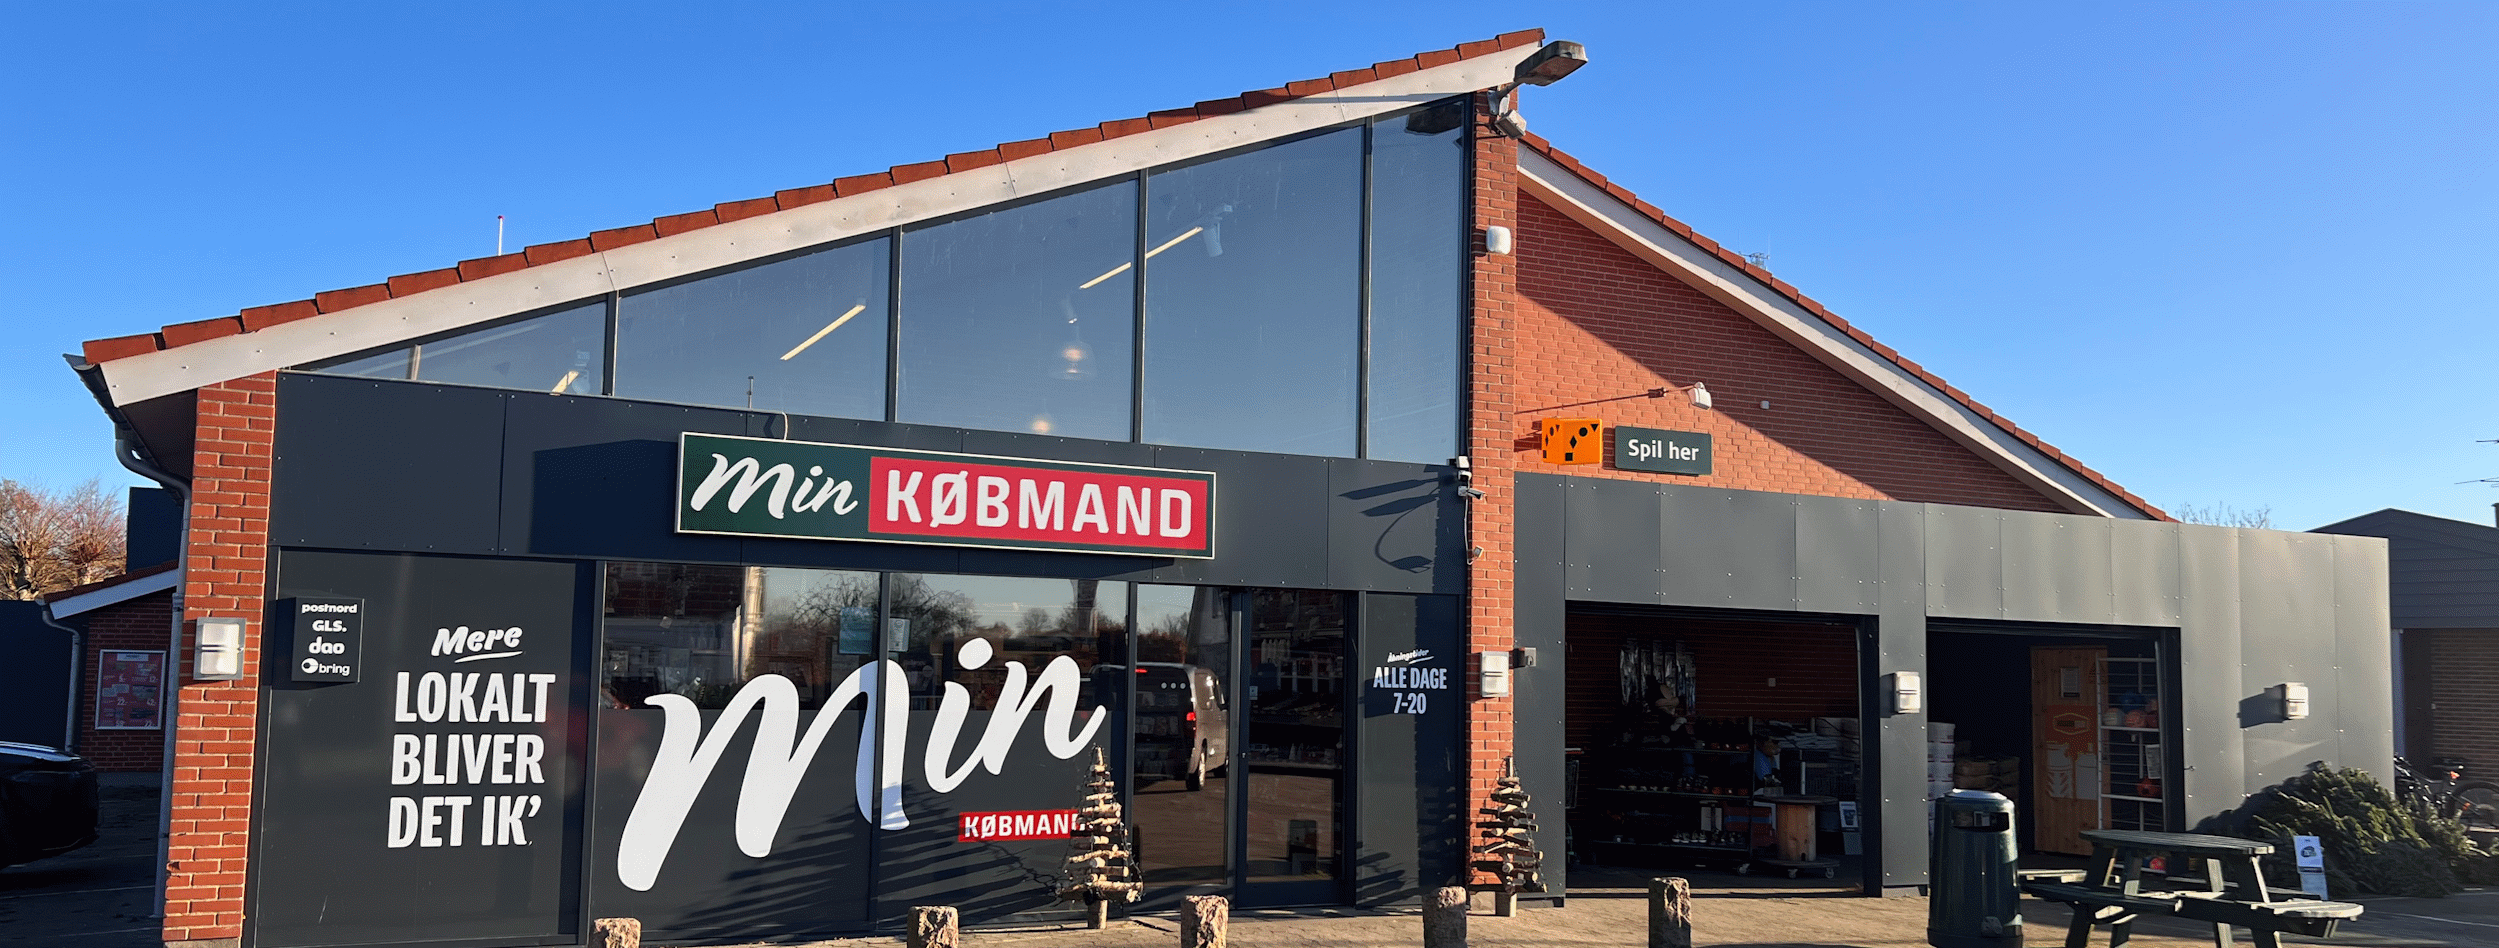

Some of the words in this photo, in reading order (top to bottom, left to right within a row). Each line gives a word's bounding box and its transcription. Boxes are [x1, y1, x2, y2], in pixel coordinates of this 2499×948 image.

[1627, 438, 1663, 462] Spil
[1668, 440, 1700, 461] her
[690, 452, 858, 520] Min
[886, 469, 1192, 538] KØBMAND
[301, 603, 358, 614] postnord
[311, 619, 348, 633] GLS.
[308, 635, 346, 655] dao
[430, 625, 523, 657] Mere
[318, 663, 351, 677] bring
[1372, 666, 1408, 689] ALLE
[1410, 667, 1448, 690] DAGE
[394, 671, 557, 723] LOKALT
[1393, 692, 1427, 715] 7-20
[390, 733, 545, 786] BLIVER
[387, 795, 471, 849] DET
